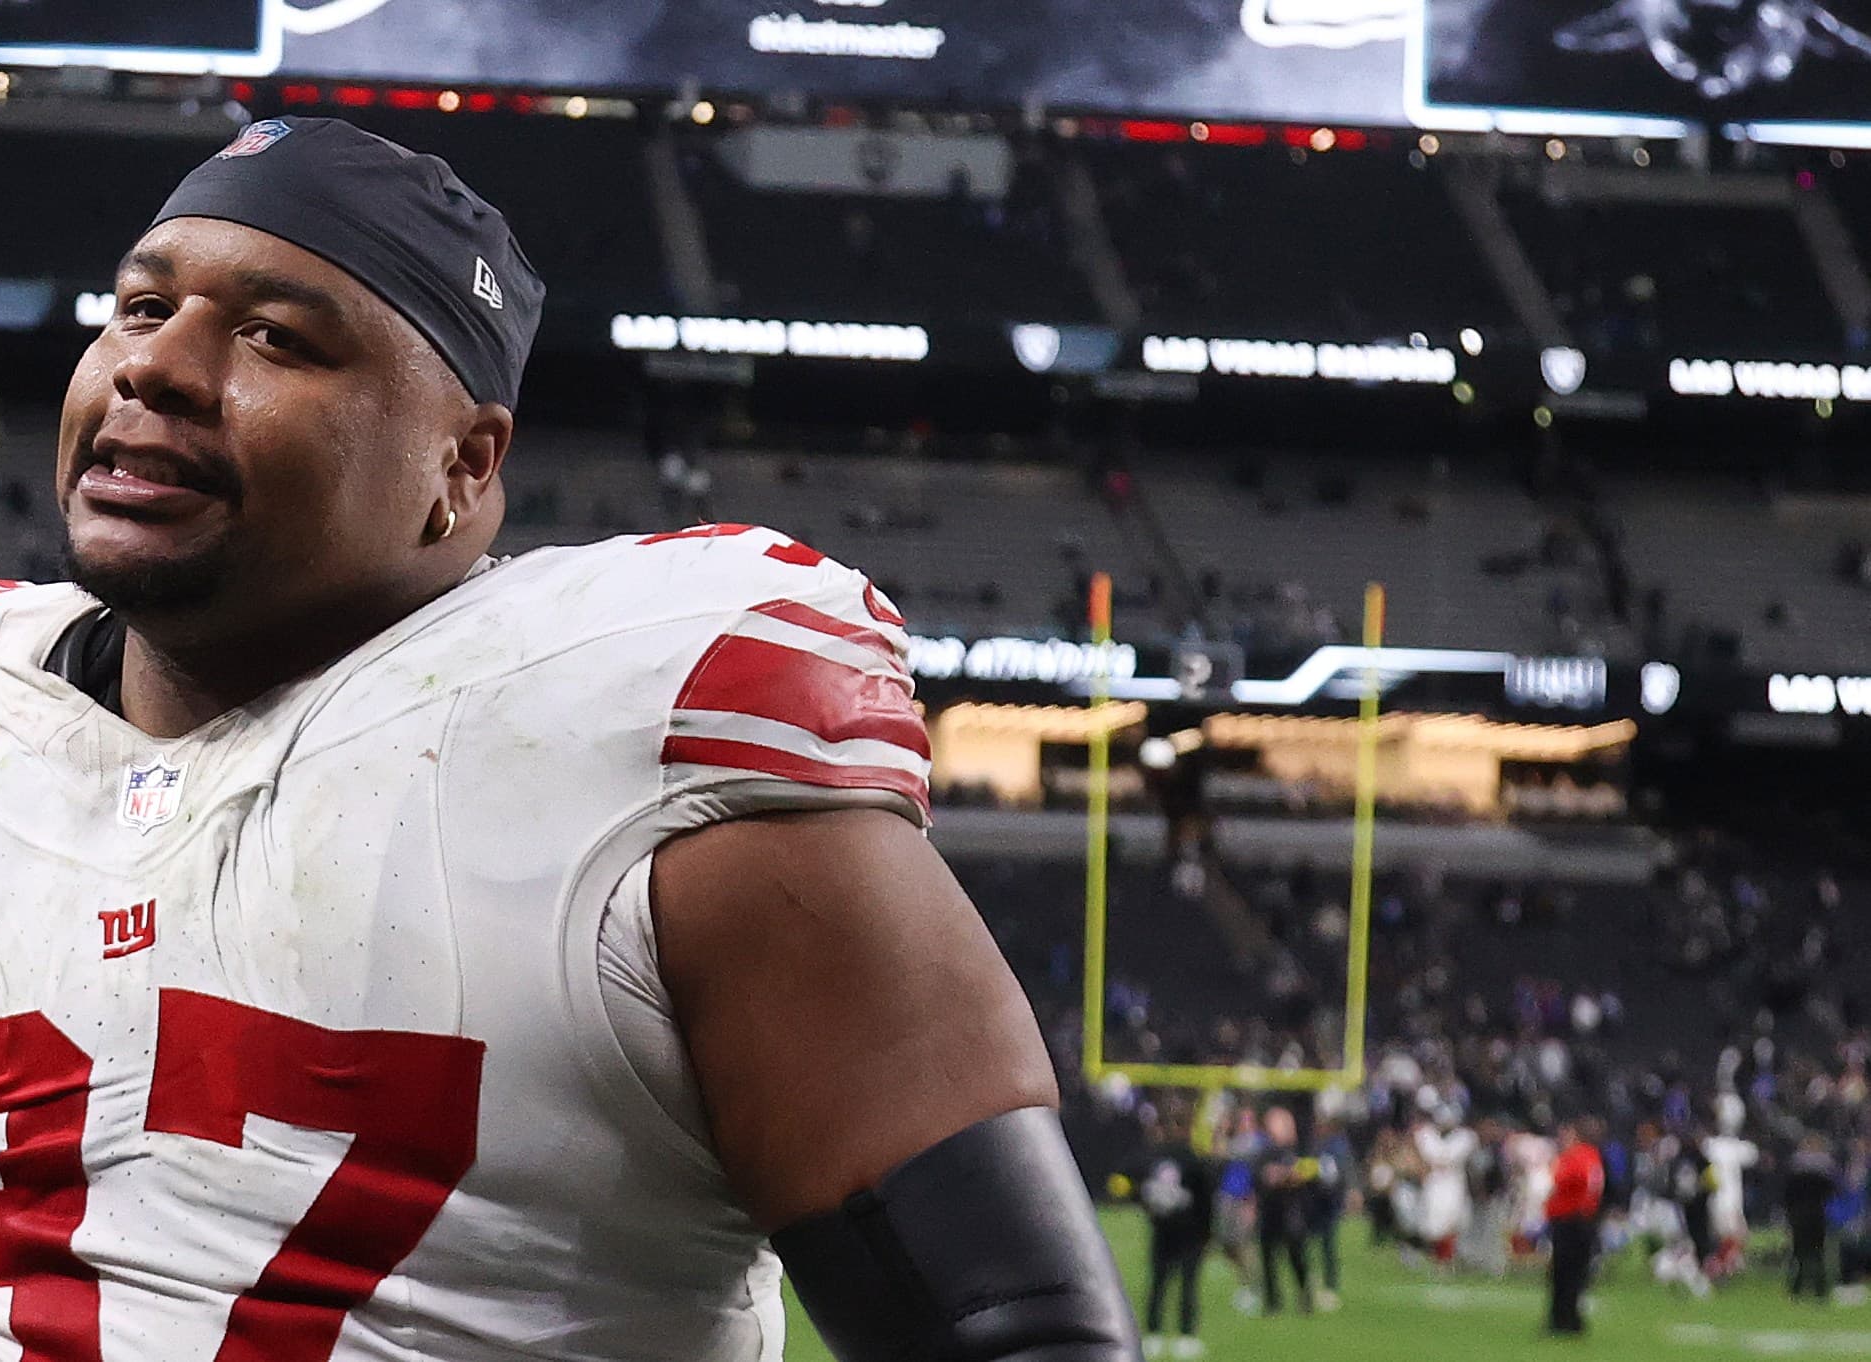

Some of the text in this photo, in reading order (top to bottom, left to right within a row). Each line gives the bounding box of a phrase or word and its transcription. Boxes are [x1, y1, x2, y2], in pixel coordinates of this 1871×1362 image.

[611, 314, 929, 360] LAS VEGAS RAIDERS
[1143, 335, 1456, 383] LAS VEGAS RAIDERS
[1669, 358, 1733, 395] LAS
[1733, 361, 1840, 399] VEGAS
[1768, 674, 1836, 714] LAS
[130, 790, 171, 818] NFL
